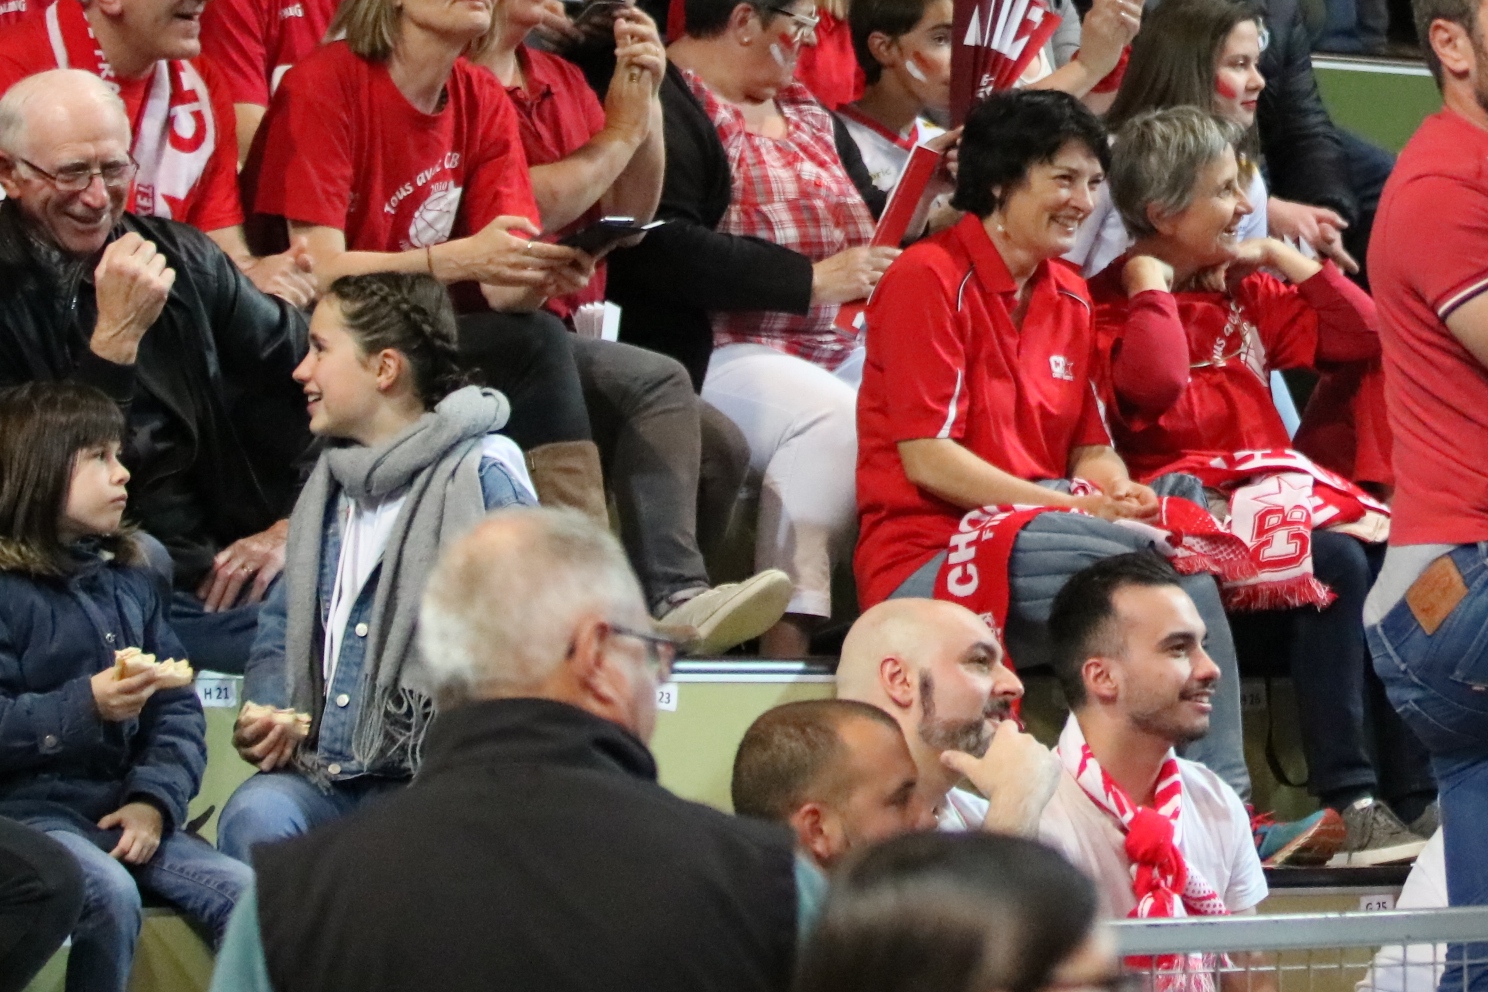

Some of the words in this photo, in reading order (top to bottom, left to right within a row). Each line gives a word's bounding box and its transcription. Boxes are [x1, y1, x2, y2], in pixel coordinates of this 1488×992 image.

[204, 687, 212, 700] H
[216, 687, 230, 700] 21
[658, 691, 671, 705] 23
